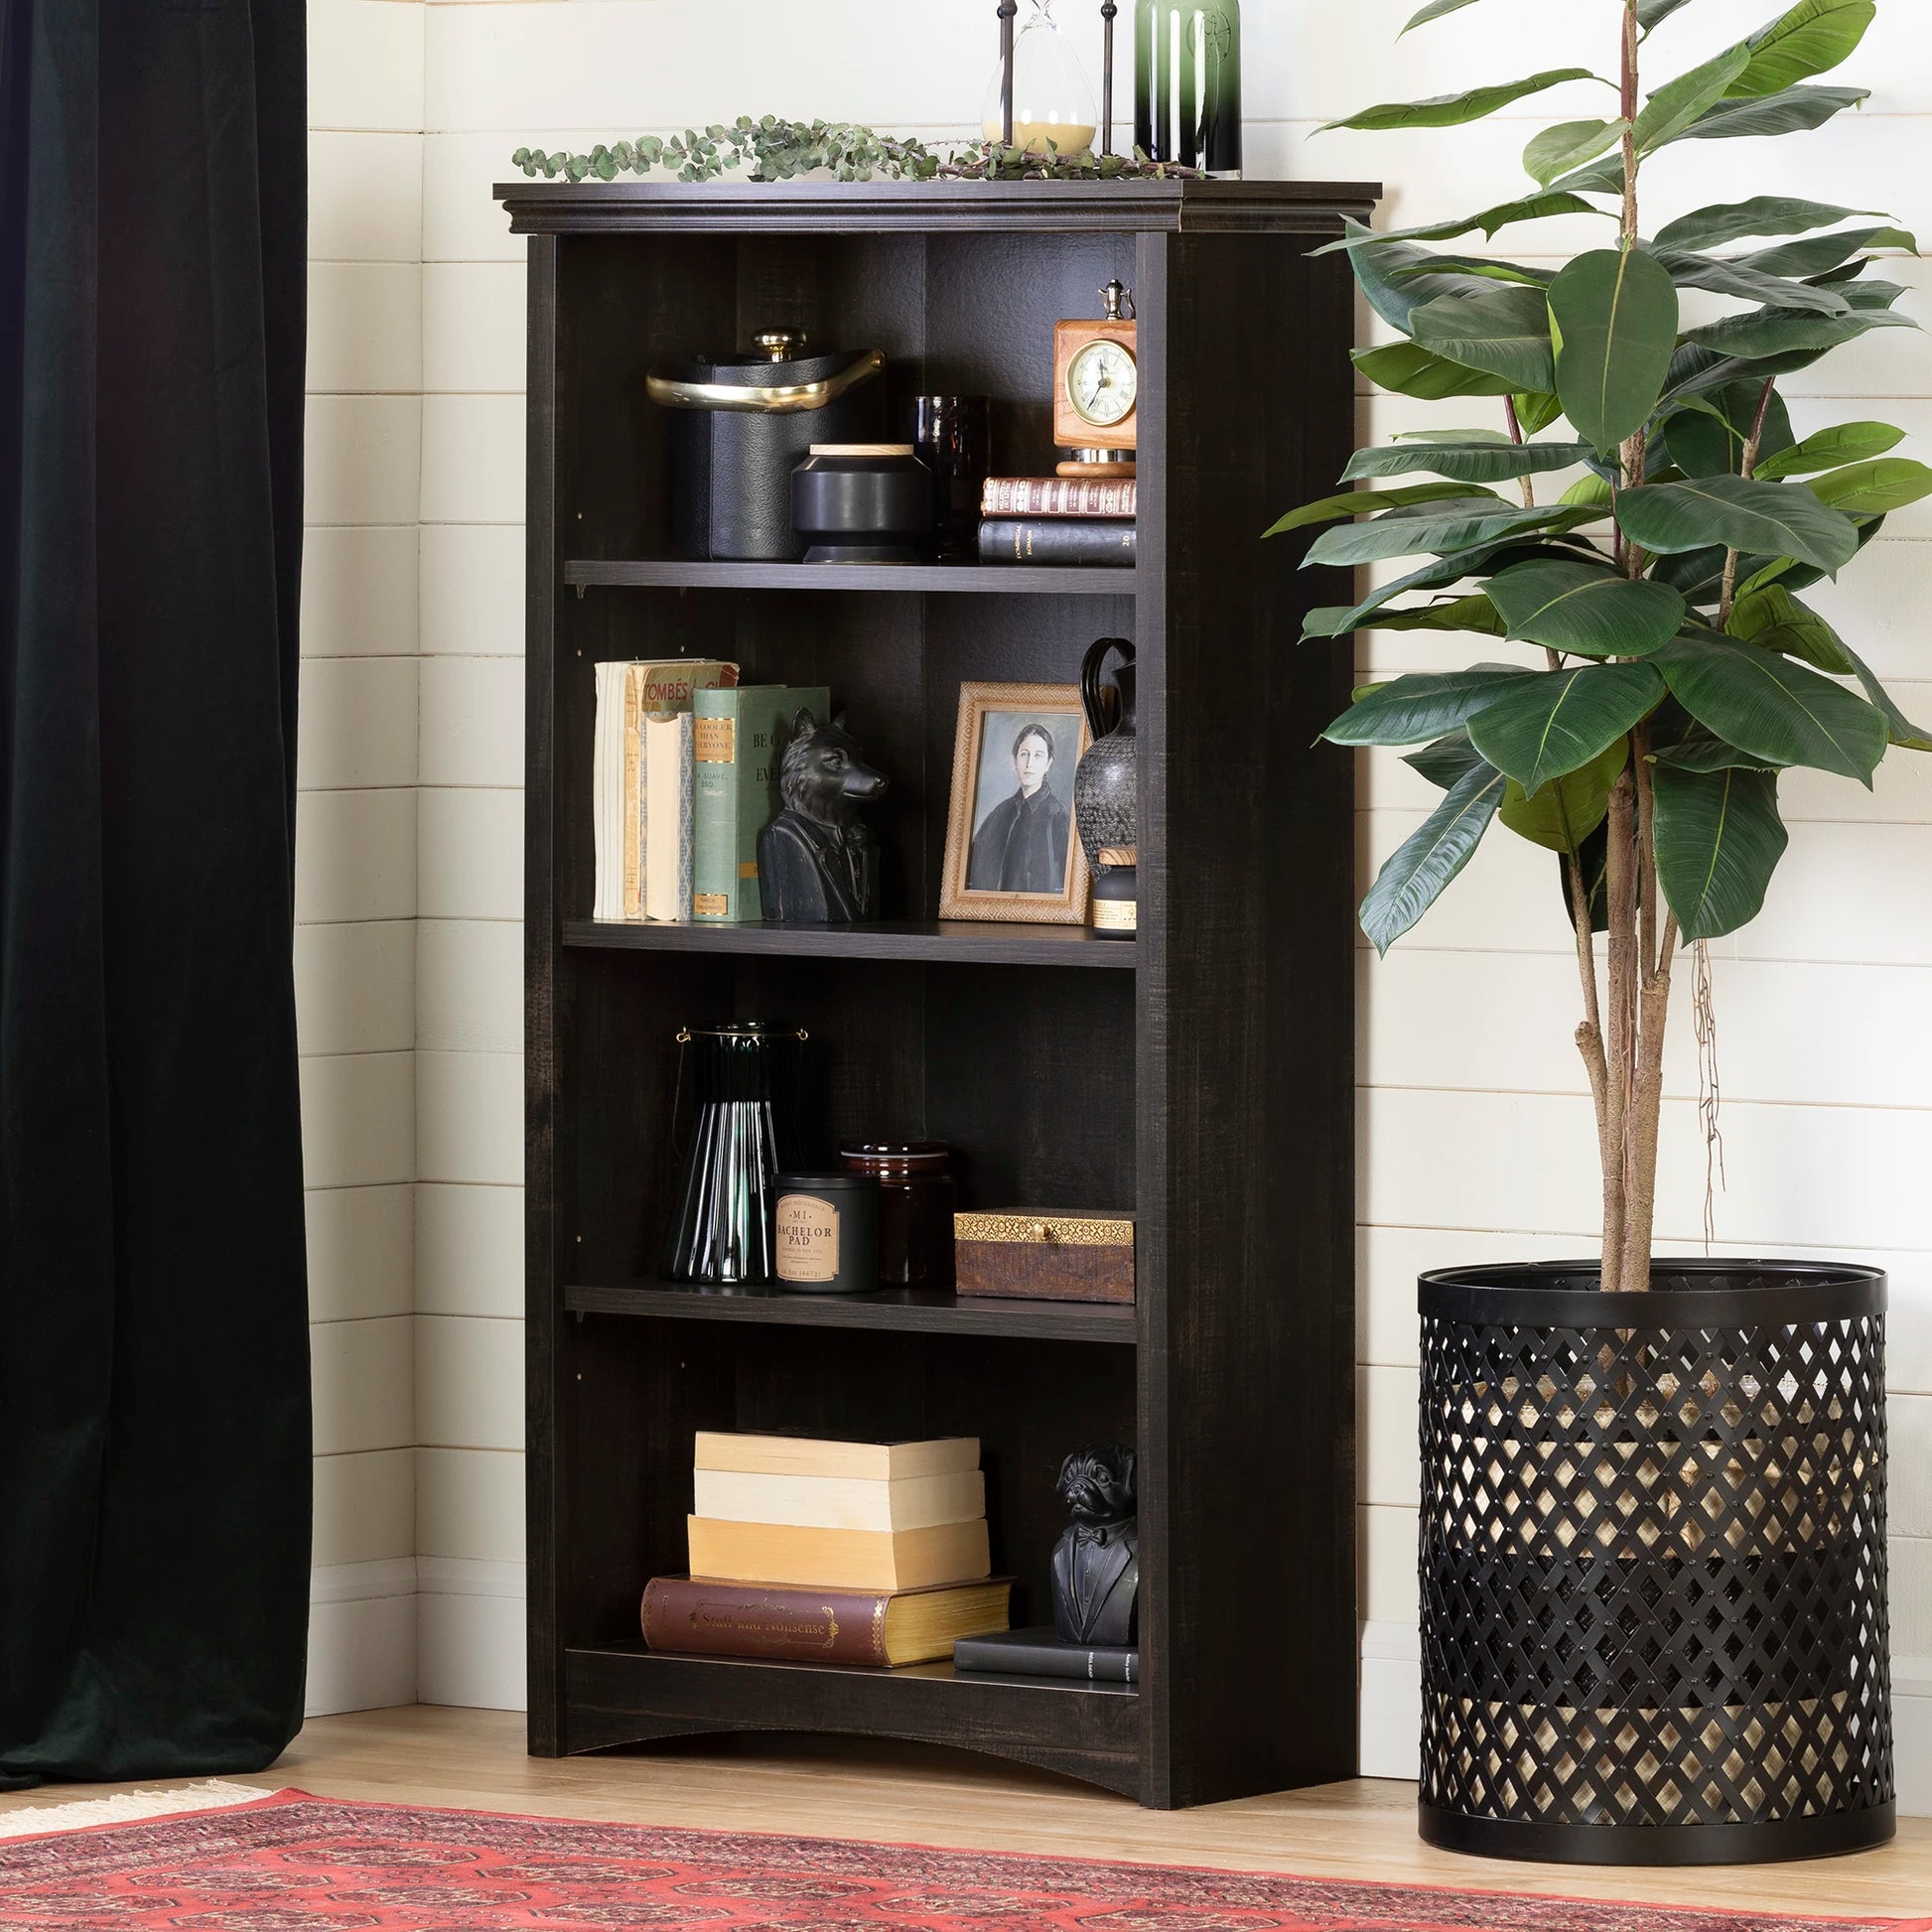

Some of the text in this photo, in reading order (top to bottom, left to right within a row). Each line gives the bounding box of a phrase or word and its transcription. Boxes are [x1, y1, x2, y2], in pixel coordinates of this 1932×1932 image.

[1122, 536, 1130, 547] 20
[754, 734, 767, 748] BE
[777, 1224, 832, 1237] BACHELOR
[789, 1235, 810, 1246] PAD
[703, 1612, 825, 1635] Stuff and Nonsense
